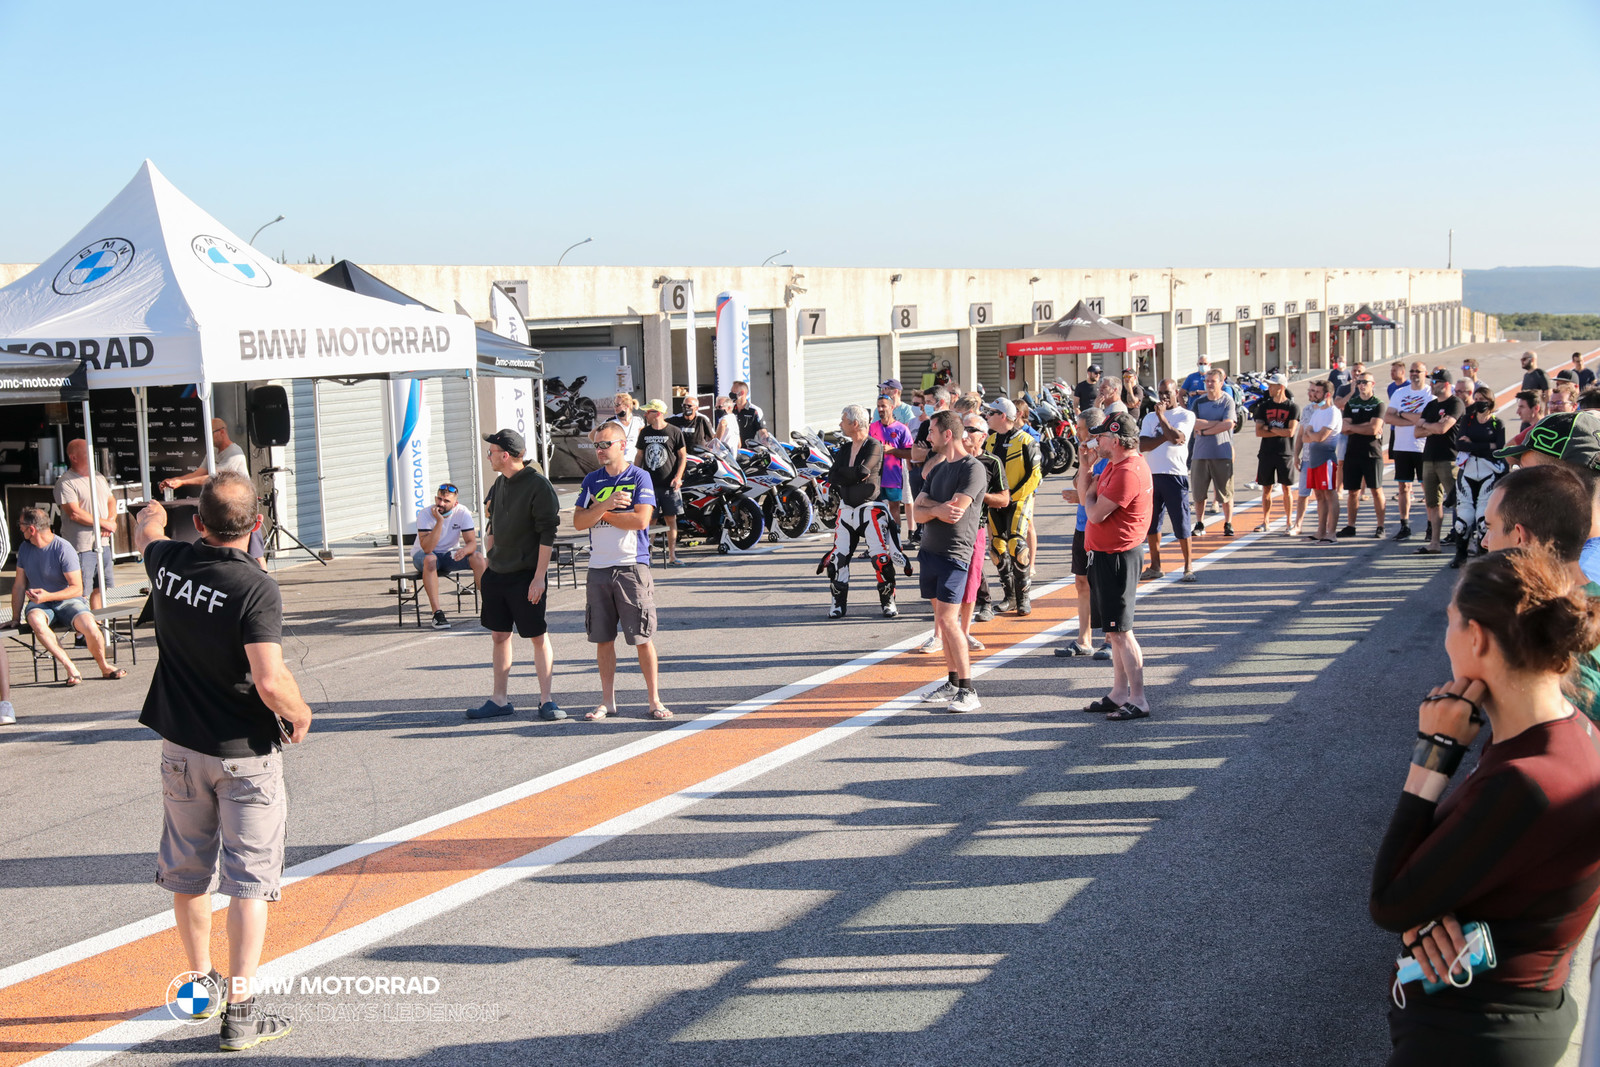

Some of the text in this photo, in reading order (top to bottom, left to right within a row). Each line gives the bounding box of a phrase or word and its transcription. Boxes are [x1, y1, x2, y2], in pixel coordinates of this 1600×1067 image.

[673, 285, 685, 309] 6
[1088, 300, 1102, 315] 11
[1133, 299, 1147, 312] 12
[1263, 304, 1274, 315] 16
[1286, 303, 1296, 313] 17
[1307, 301, 1317, 310] 18
[1329, 306, 1339, 315] 19
[1344, 305, 1354, 314] 20
[1373, 303, 1383, 312] 22
[900, 308, 911, 328] 8
[977, 306, 987, 324] 9
[1036, 304, 1052, 320] 10
[1208, 311, 1220, 323] 14
[1238, 308, 1249, 319] 15
[808, 313, 820, 335] 7
[238, 325, 450, 361] BMW MOTORRAD
[1091, 342, 1114, 350] Bihr
[495, 356, 535, 368] bmc-moto.com
[155, 566, 228, 613] STAFF
